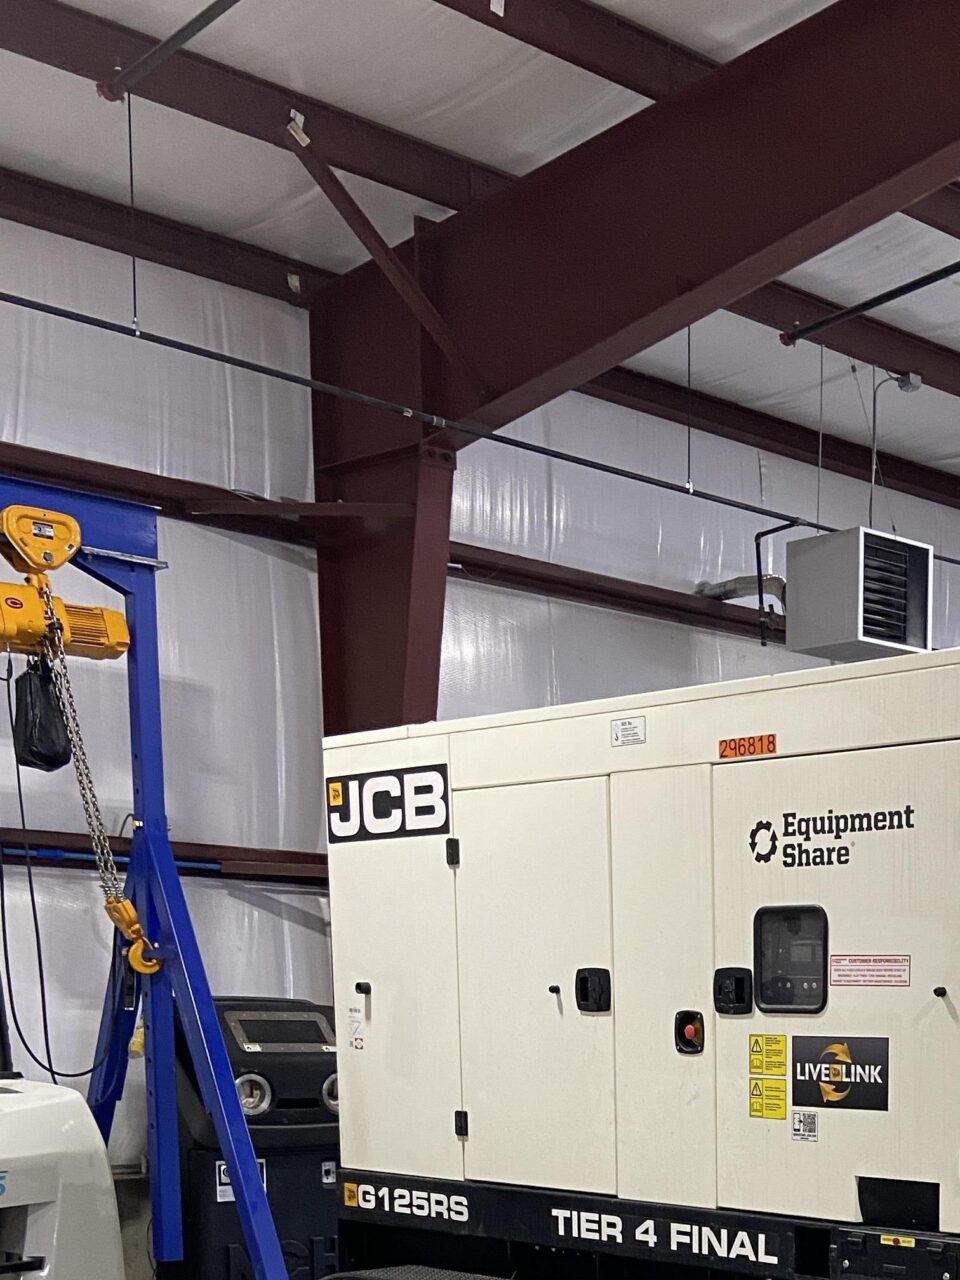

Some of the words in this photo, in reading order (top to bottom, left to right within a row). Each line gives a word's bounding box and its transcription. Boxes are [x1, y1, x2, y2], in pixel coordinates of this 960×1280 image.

[720, 735, 776, 758] 296818
[330, 771, 447, 837] JCB
[782, 805, 915, 842] Equipment
[782, 843, 850, 868] Share
[796, 1062, 830, 1081] LIVE
[842, 1064, 883, 1084] LINK
[357, 1184, 469, 1222] G125RS
[551, 1208, 624, 1244] TIER
[635, 1219, 658, 1248] 4
[670, 1222, 779, 1265] FINAL
